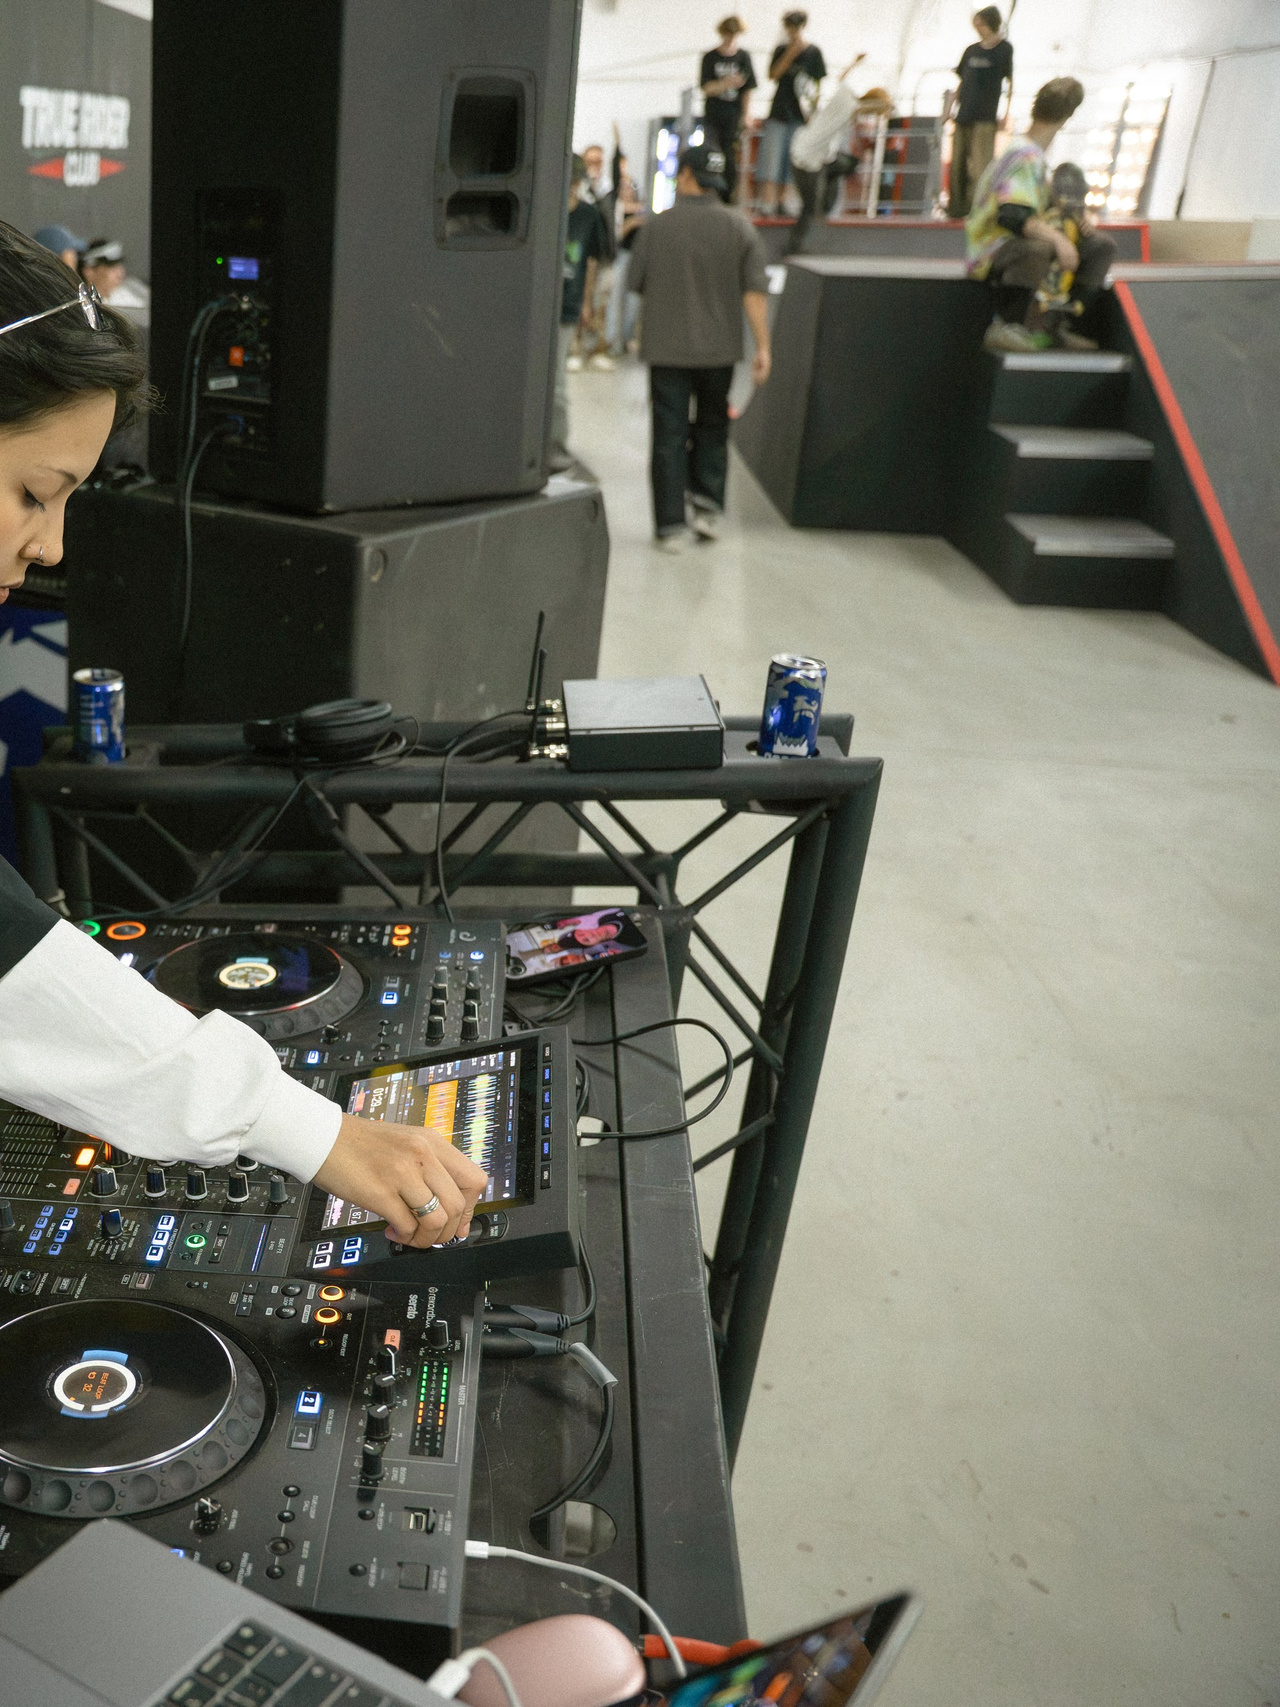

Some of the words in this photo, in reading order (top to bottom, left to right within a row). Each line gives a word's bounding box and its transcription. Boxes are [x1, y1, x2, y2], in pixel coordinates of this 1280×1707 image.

[277, 1238, 286, 1248] BEAT
[3, 1274, 13, 1288] SEARCH
[406, 1294, 418, 1320] serato
[339, 1334, 349, 1357] RELOOP/EXIT
[99, 1372, 110, 1385] BEAT
[82, 1383, 94, 1392] 32
[94, 1385, 106, 1400] LOOP
[458, 1384, 466, 1406] MASTER
[325, 1420, 334, 1435] SELECT
